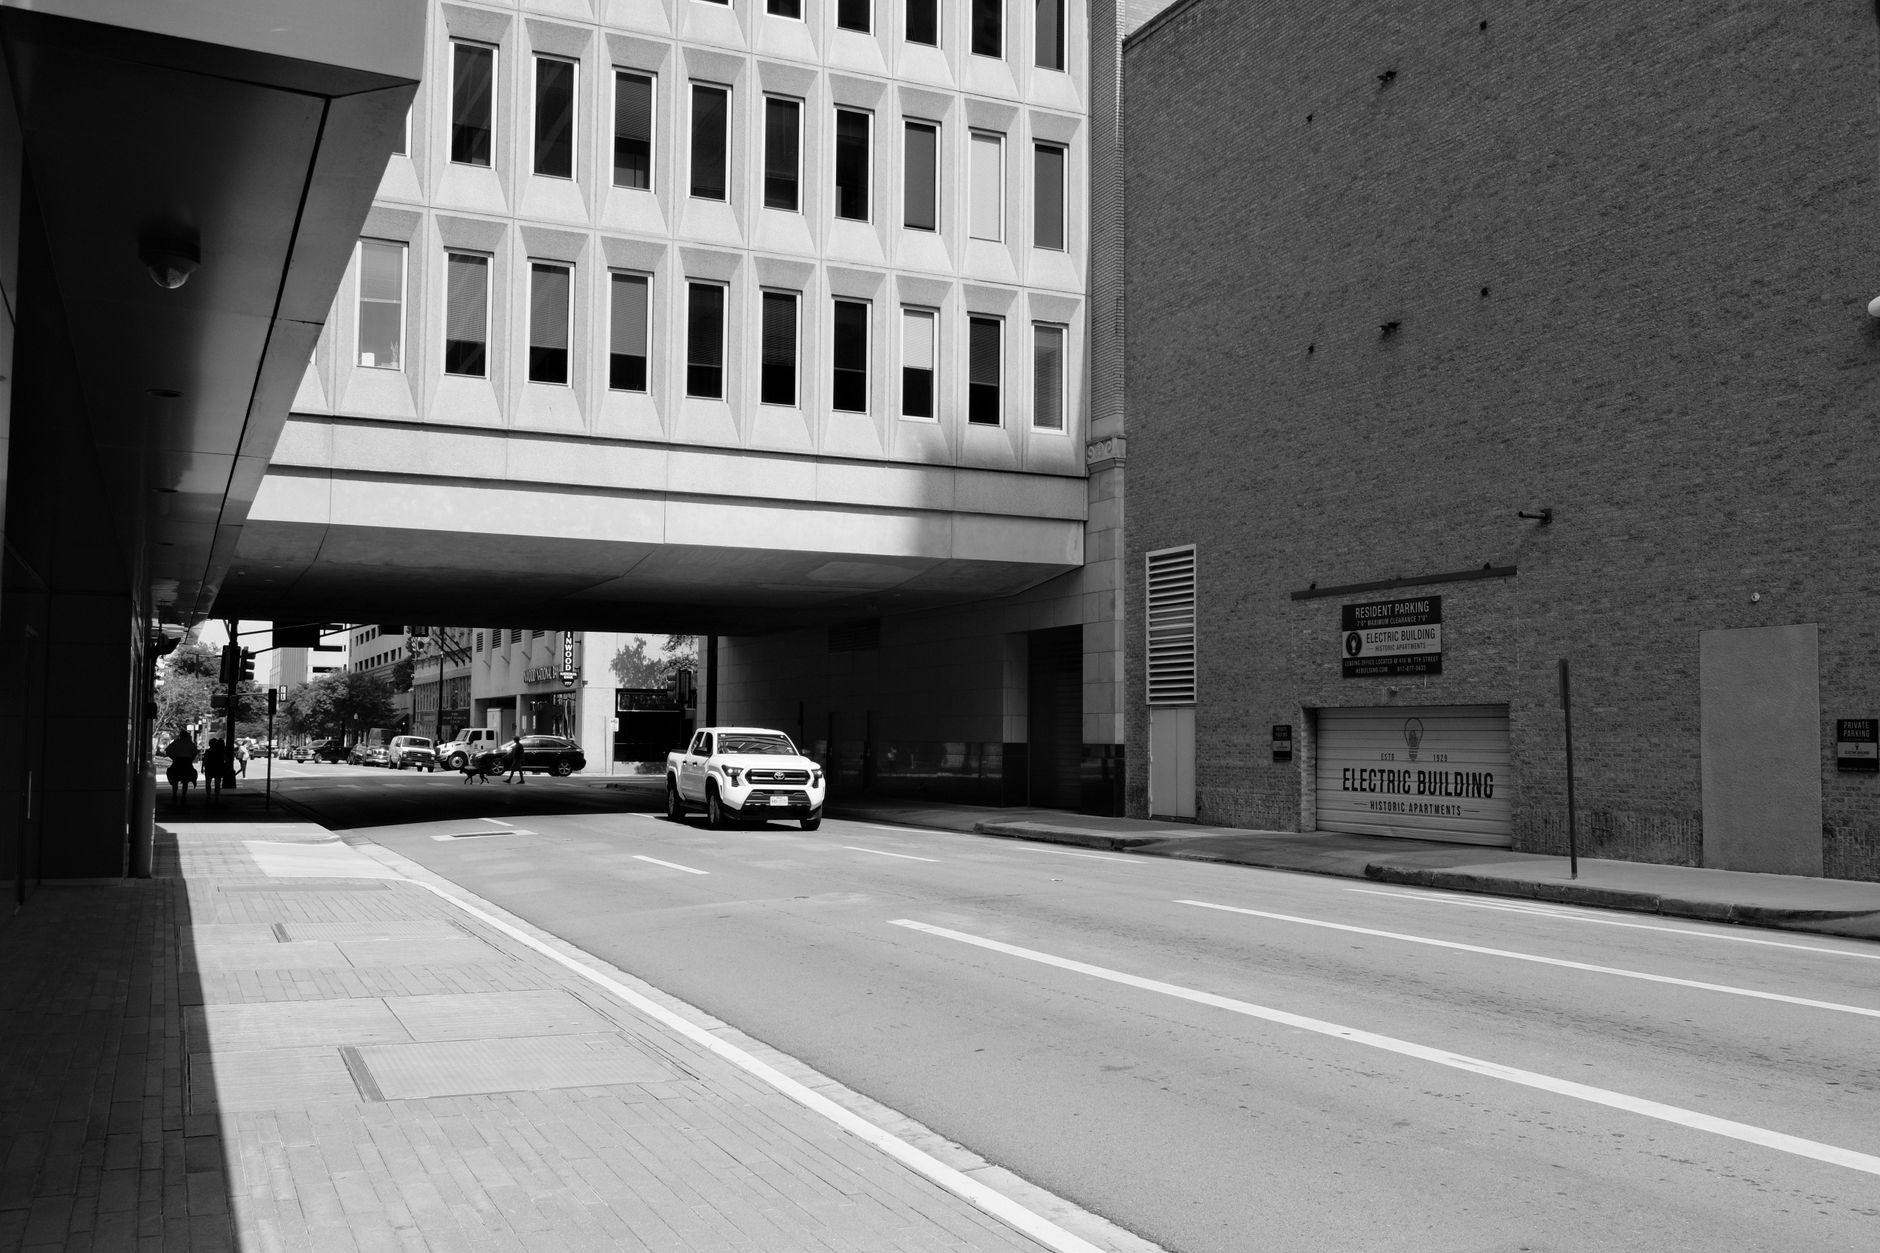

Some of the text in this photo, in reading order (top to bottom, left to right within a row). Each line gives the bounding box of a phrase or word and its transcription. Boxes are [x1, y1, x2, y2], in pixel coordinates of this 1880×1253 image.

[1355, 600, 1430, 619] RESIDENT PARKING
[1367, 618, 1389, 626] MAXIMUM
[1389, 616, 1417, 625] CLEARANCE
[1366, 628, 1436, 644] ELECTRIC BUILDING
[564, 631, 573, 671] INWOOD
[1375, 642, 1426, 652] HISTORIC APARTMENTS
[1843, 721, 1870, 729] PRIVATE
[1843, 729, 1870, 738] PARKING
[1433, 754, 1448, 762] 1929
[1342, 768, 1494, 799] ELECTRIC BUILDING
[1370, 801, 1461, 816] HISTORIC APARTMENTS
